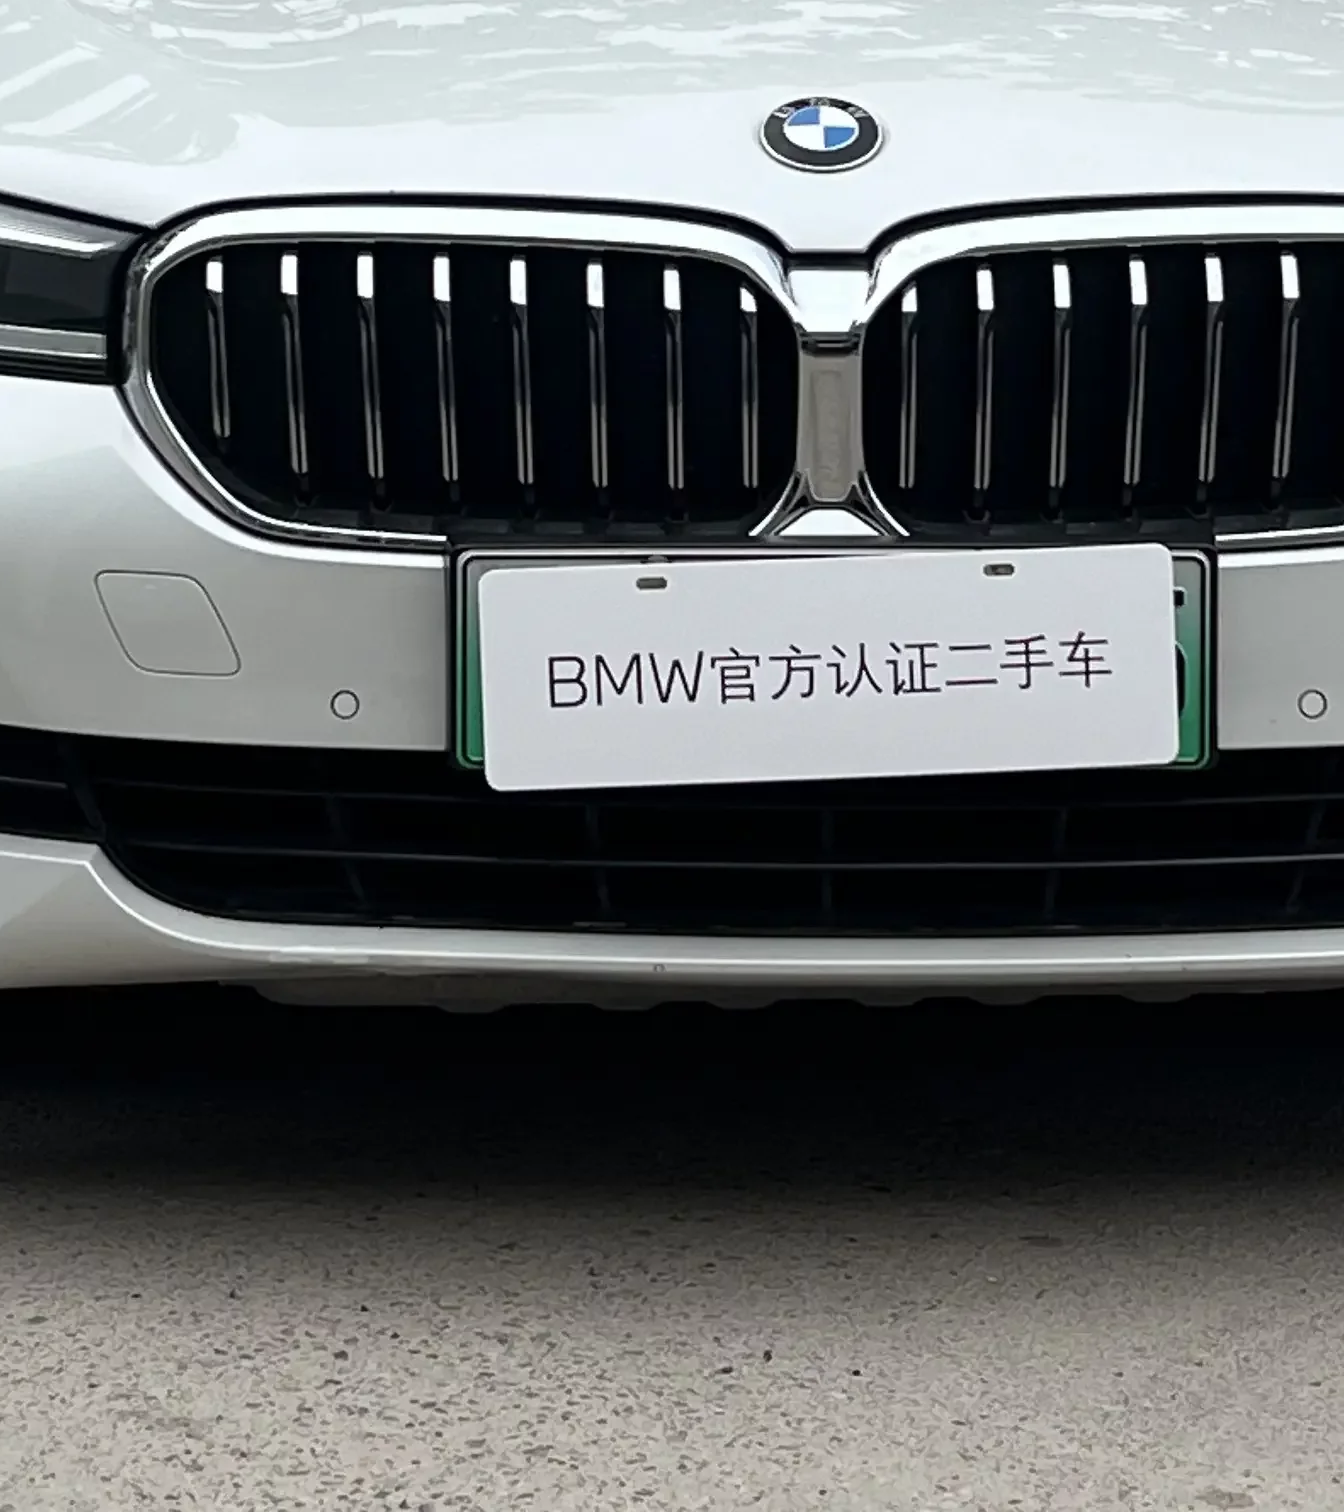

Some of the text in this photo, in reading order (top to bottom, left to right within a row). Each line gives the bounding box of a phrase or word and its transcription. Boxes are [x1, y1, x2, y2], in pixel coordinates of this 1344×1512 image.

[547, 630, 1114, 709] BMW官方认证二手车
